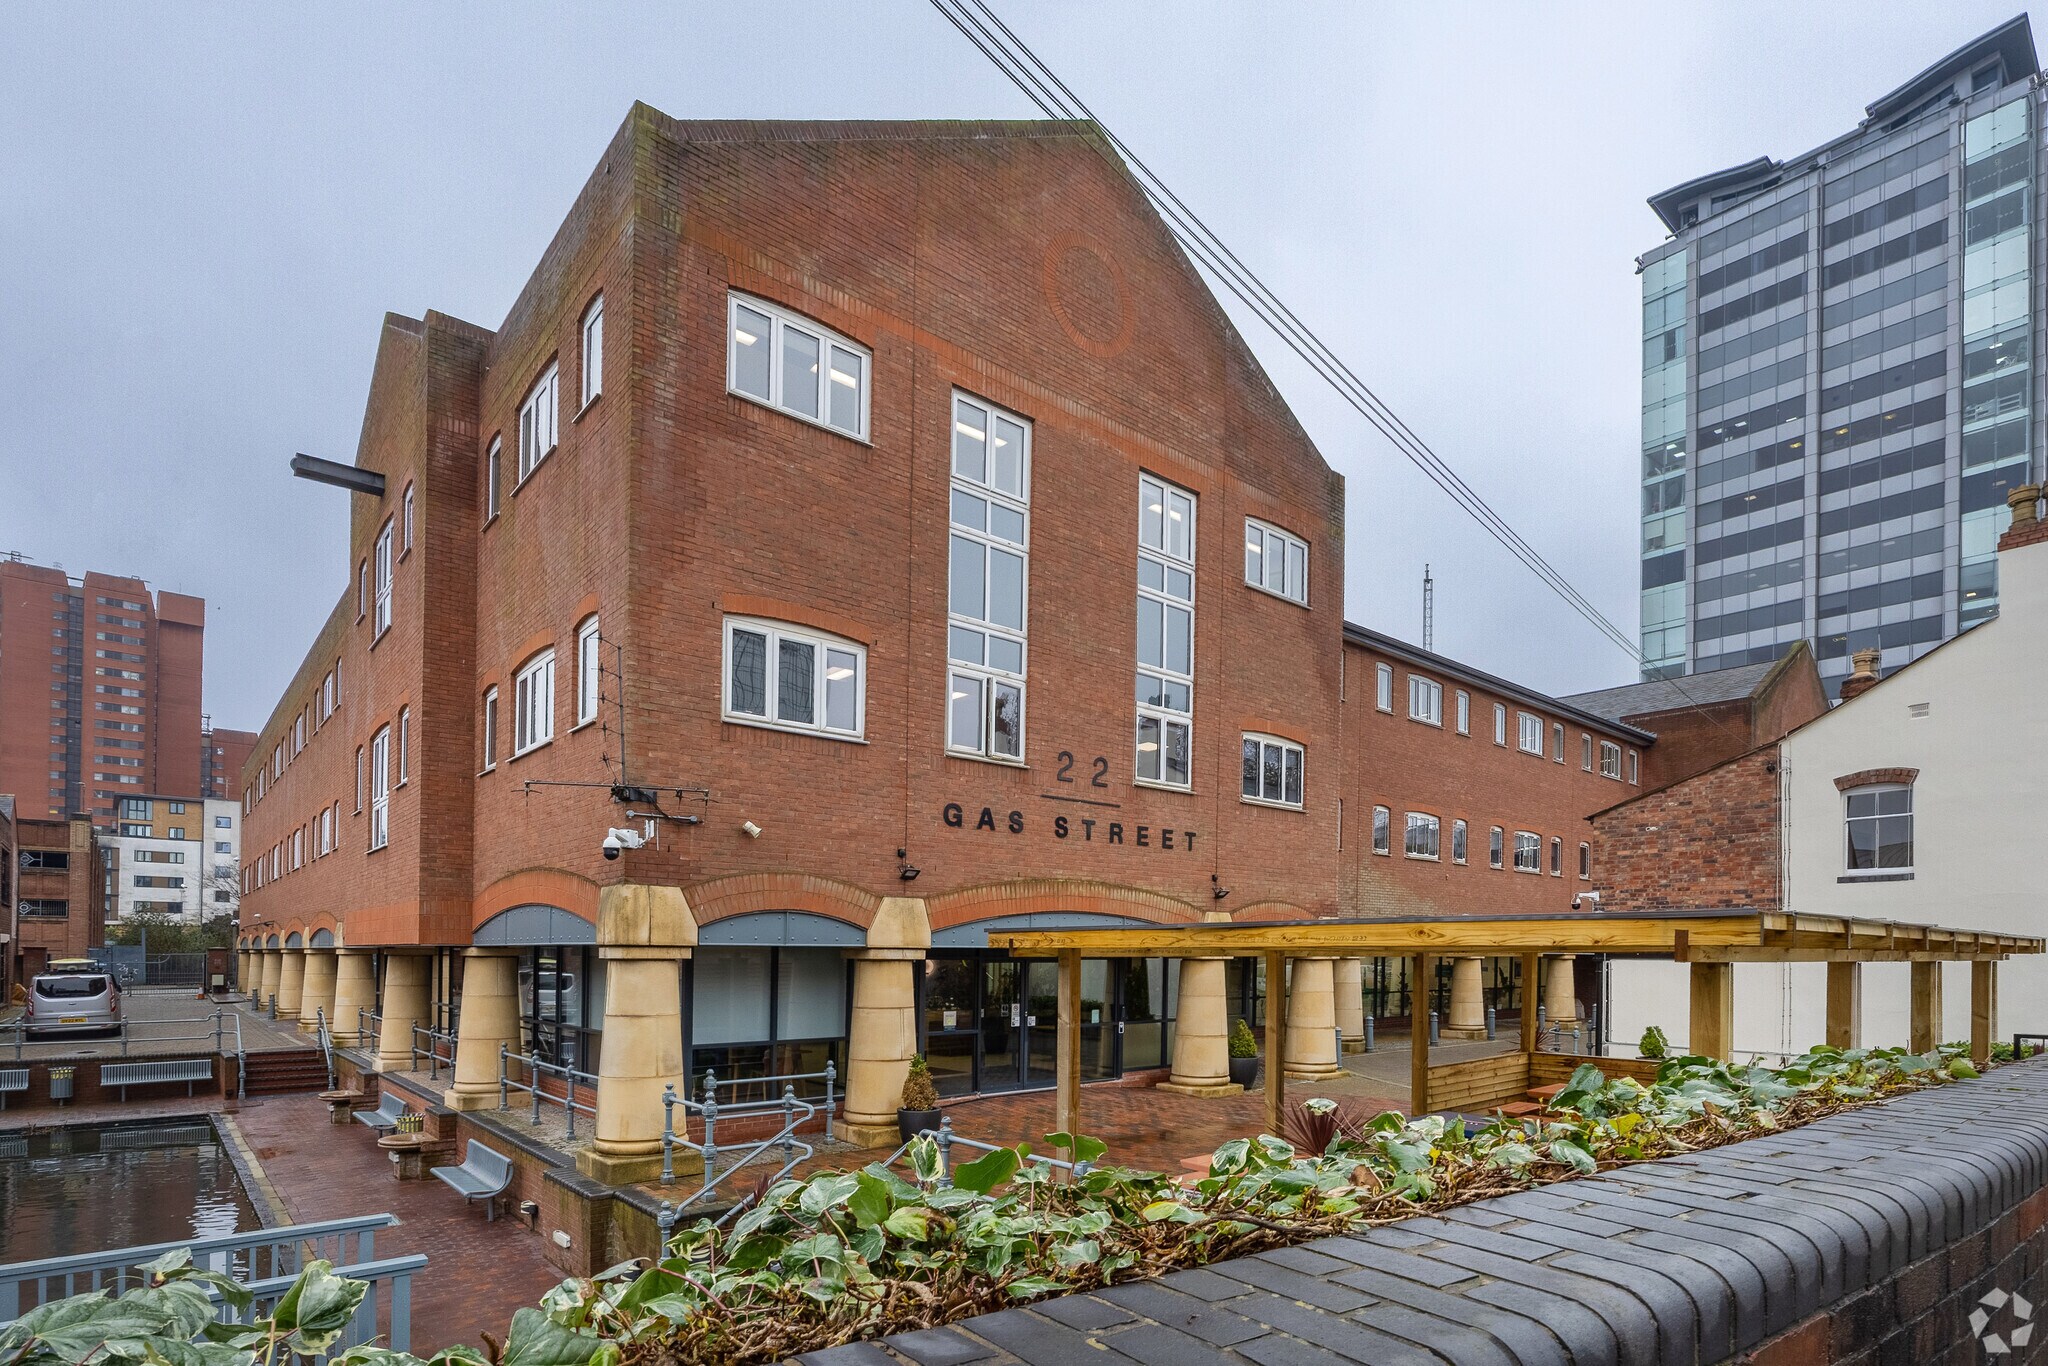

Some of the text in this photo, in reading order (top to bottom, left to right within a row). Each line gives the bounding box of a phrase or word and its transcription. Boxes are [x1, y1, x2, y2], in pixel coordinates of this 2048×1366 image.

[1057, 751, 1108, 787] 22
[943, 803, 1197, 852] GAS STREET
